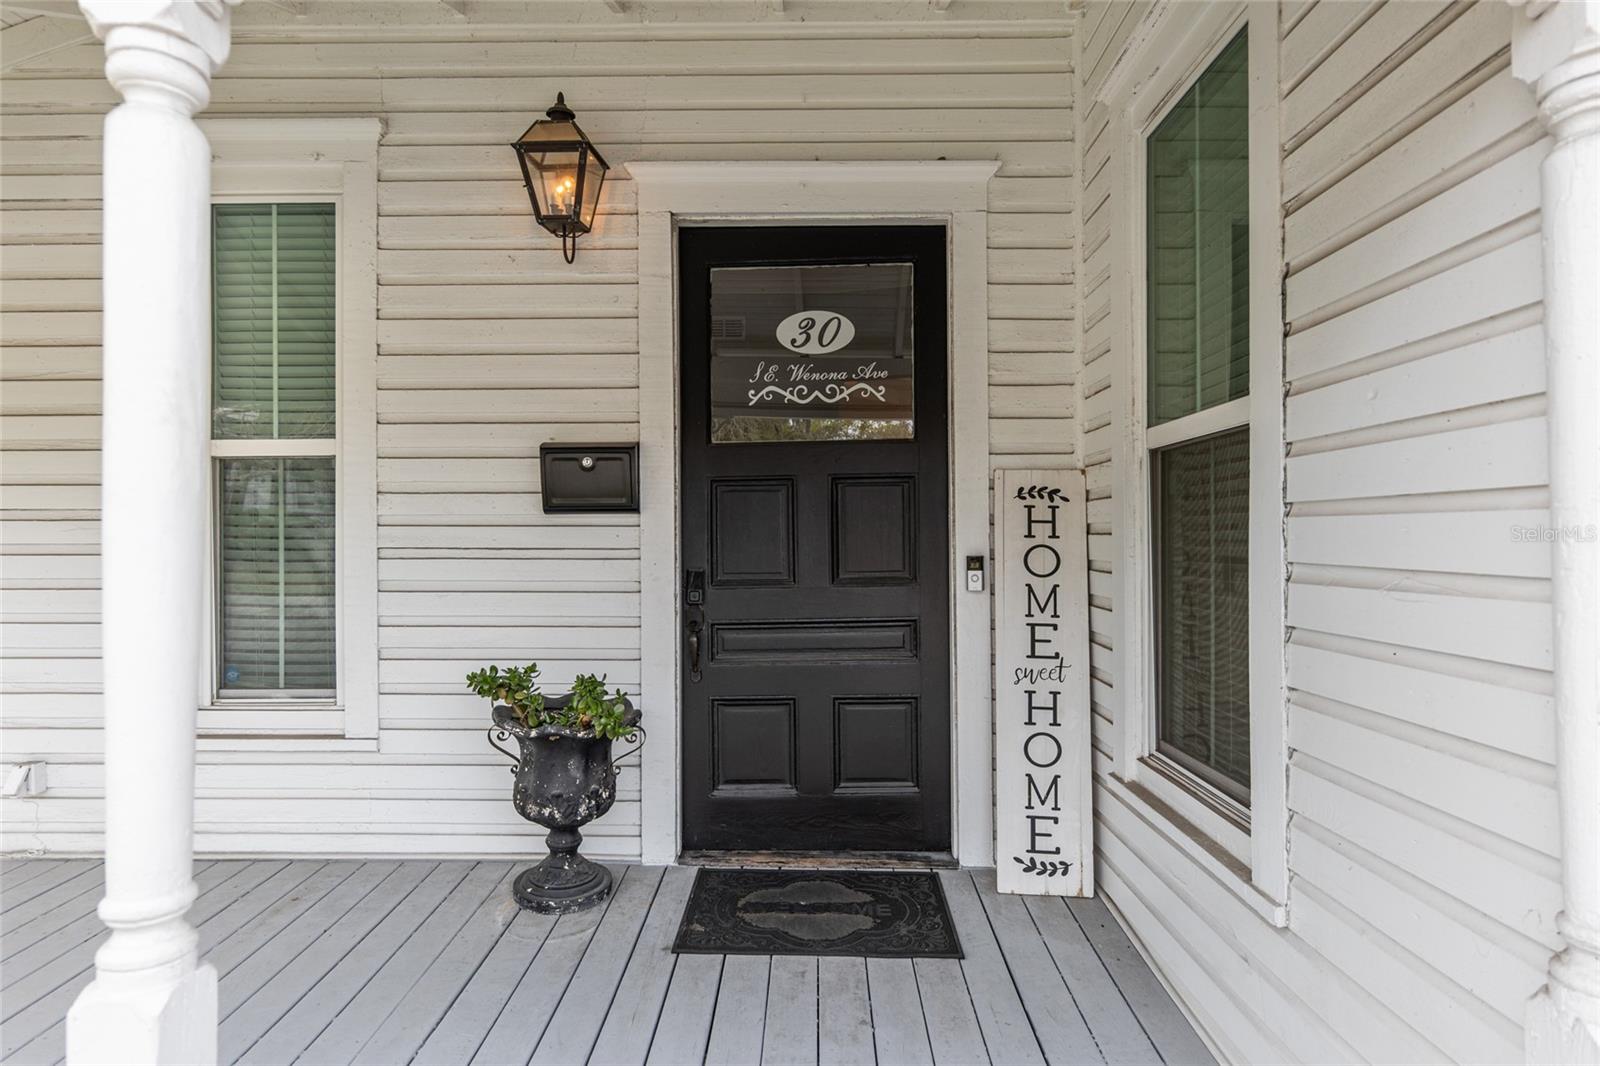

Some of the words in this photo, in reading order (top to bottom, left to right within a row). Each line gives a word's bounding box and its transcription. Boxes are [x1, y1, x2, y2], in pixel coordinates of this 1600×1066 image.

[790, 317, 842, 348] 30
[787, 363, 848, 381] Wenona
[852, 361, 889, 379] Ave
[1023, 504, 1061, 659] HOME
[1013, 656, 1072, 685] sweet
[1023, 690, 1062, 855] HOME
